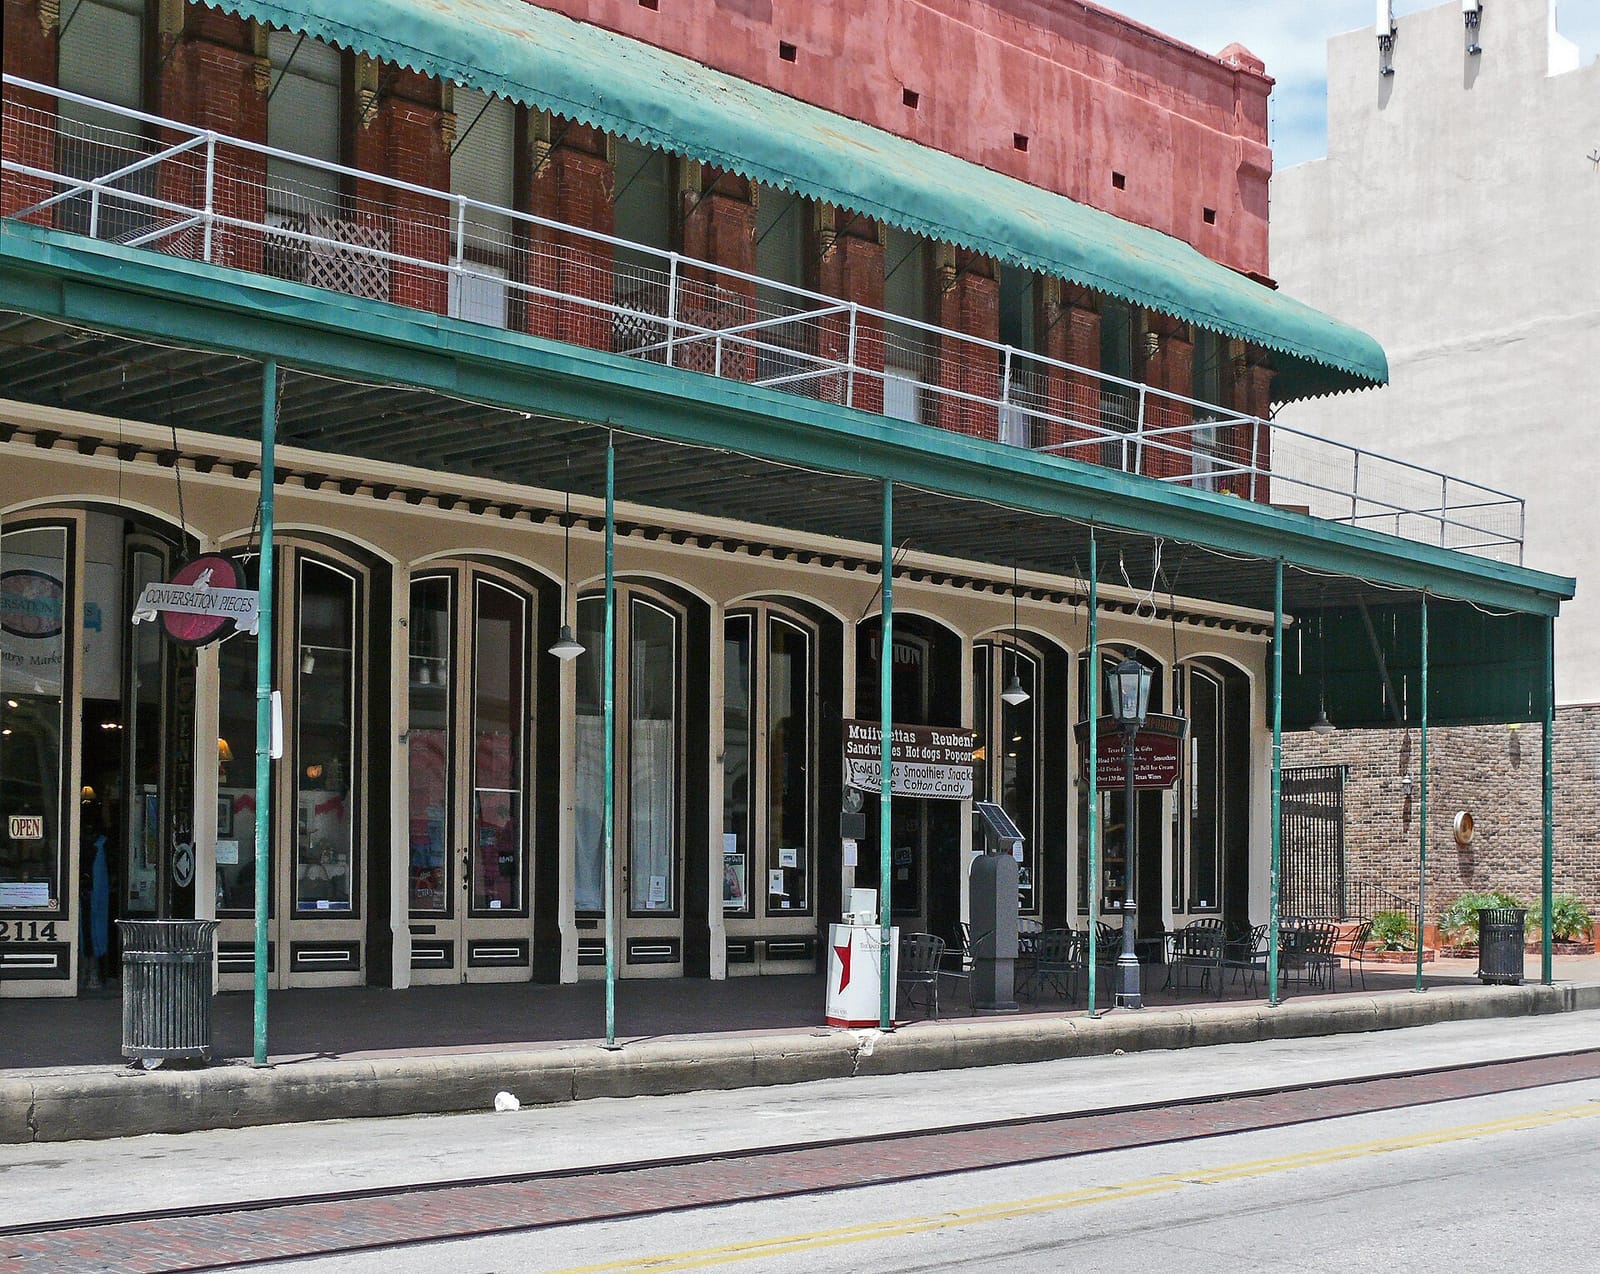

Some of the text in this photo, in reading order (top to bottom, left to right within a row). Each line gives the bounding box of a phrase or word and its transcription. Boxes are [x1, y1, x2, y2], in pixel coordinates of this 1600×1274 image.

[144, 589, 255, 612] CONVERSATION PIECES
[30, 650, 62, 666] Marke
[847, 741, 901, 757] Sandwies
[905, 745, 919, 758] Hot
[921, 747, 941, 761] dogs
[853, 761, 873, 774] Cold
[874, 763, 900, 777] Dks
[904, 765, 945, 779] Smoothies
[904, 779, 933, 791] Cotton
[935, 781, 965, 794] Candy
[11, 818, 41, 837] OPEN
[0, 921, 58, 942] 2114
